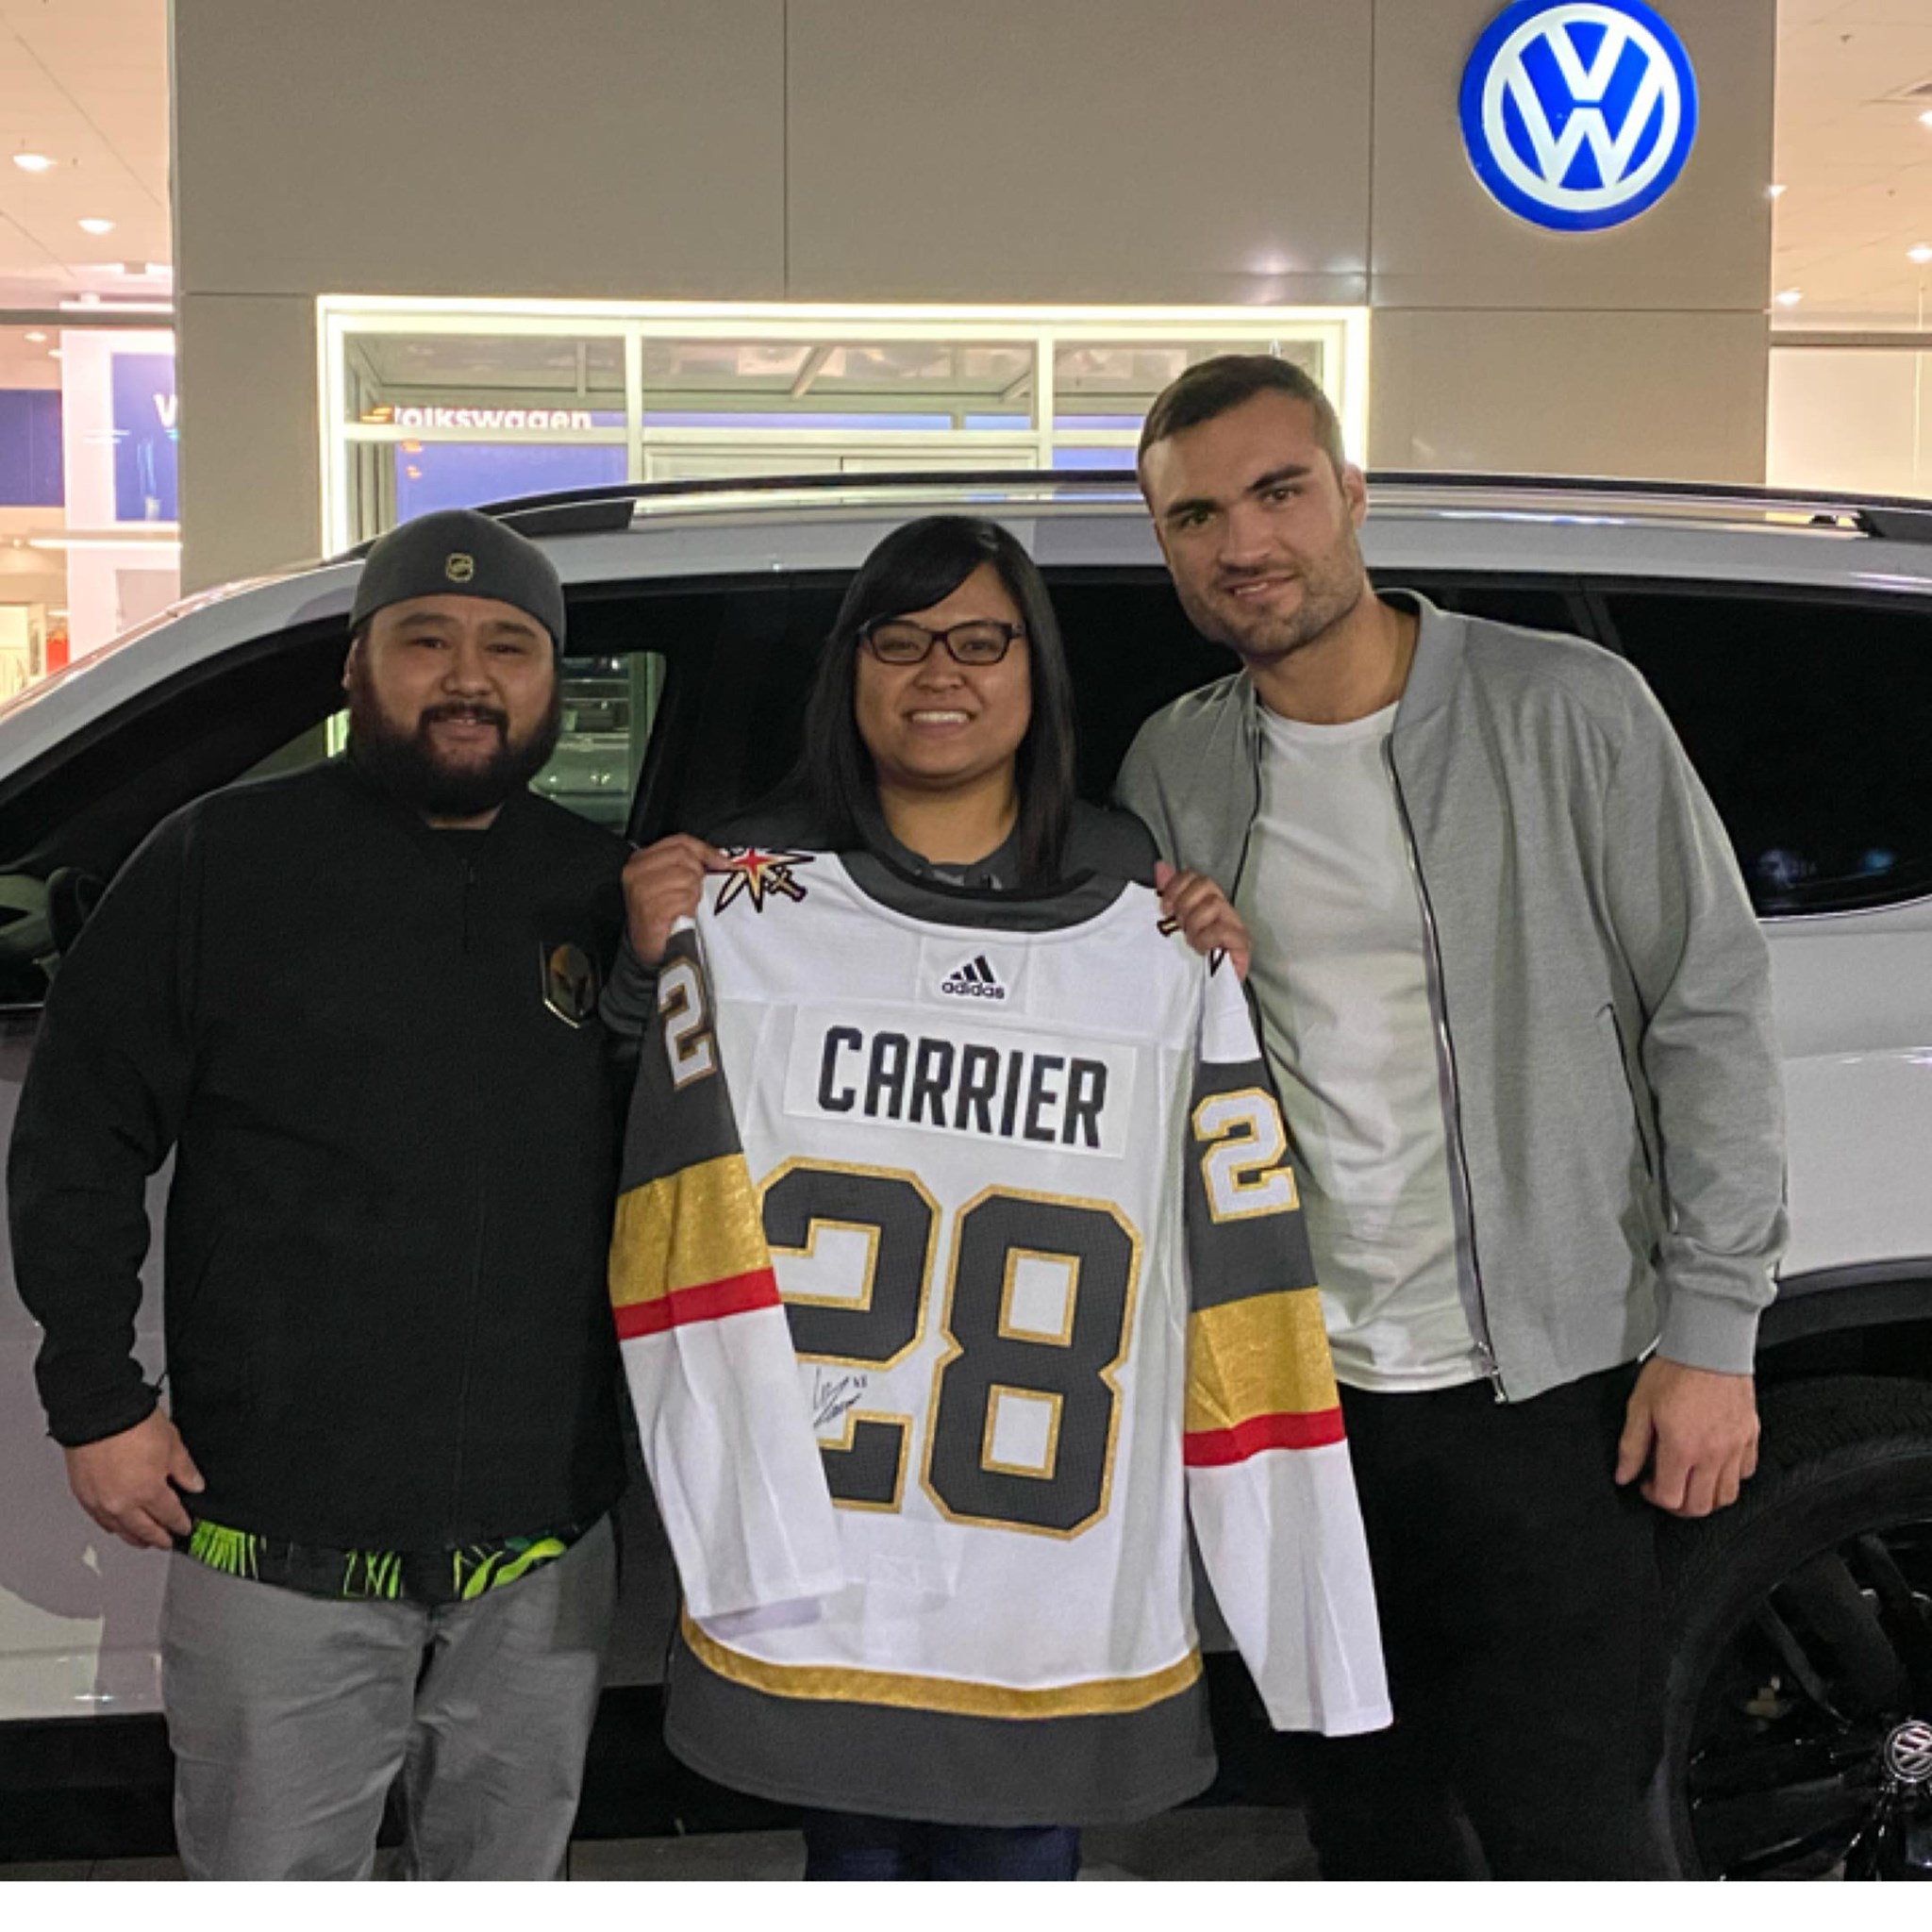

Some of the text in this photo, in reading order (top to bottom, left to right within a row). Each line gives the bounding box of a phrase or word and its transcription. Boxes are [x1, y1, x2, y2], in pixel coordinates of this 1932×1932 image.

[658, 956, 718, 1091] 2
[941, 982, 1005, 999] adidas
[818, 1025, 1108, 1148] CARRIER
[1191, 1087, 1300, 1224] 2
[757, 1156, 1142, 1541] 28
